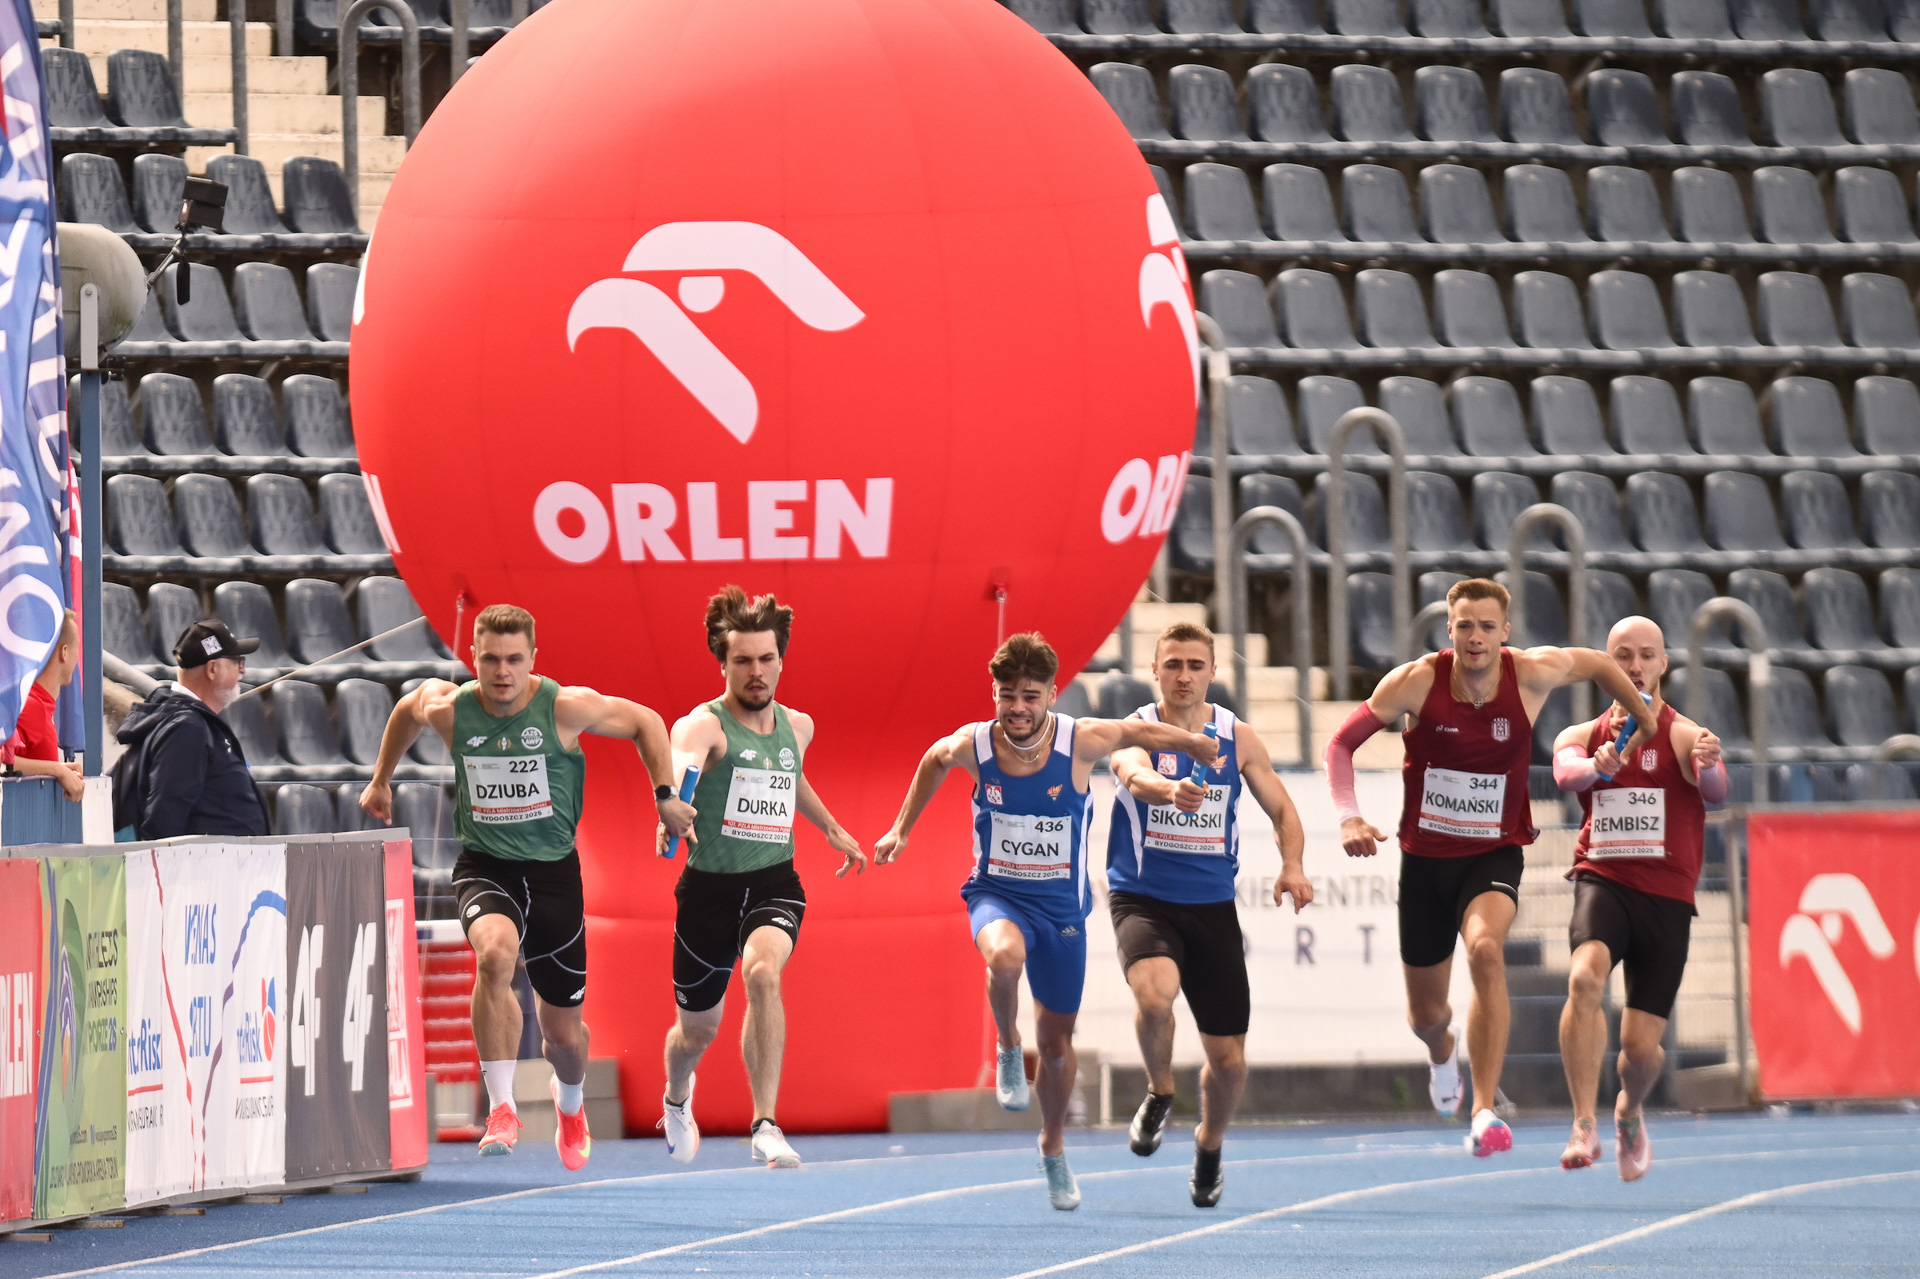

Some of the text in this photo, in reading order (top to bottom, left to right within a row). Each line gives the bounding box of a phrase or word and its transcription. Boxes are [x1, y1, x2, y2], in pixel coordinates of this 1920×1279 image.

[533, 477, 893, 563] ORLEN
[466, 736, 488, 748] 4F
[739, 749, 757, 761] 4F
[509, 760, 538, 773] 222
[769, 775, 791, 790] 220
[1469, 777, 1498, 790] 344
[476, 783, 540, 799] DZIUBA
[1628, 791, 1657, 805] 346
[737, 797, 787, 817] DURKA
[1425, 790, 1499, 813] KOMAŃSKI
[480, 810, 542, 822] BYDGOSZCZ 2025
[1151, 809, 1222, 828] SIKORSKI
[1035, 820, 1063, 833] 436
[1428, 821, 1490, 836] BYDGOSZCZ 2025
[1594, 816, 1660, 833] REMBISZ
[732, 829, 773, 840] BYDGOSZCZ
[1001, 839, 1059, 857] CYGAN
[1154, 840, 1198, 850] BYDGOSZCZ
[1596, 847, 1636, 856] BYDGOSZCZ
[998, 868, 1060, 878] BYDGOSZCZ 2025
[291, 925, 324, 1096] 4F
[343, 921, 377, 1092] 4F
